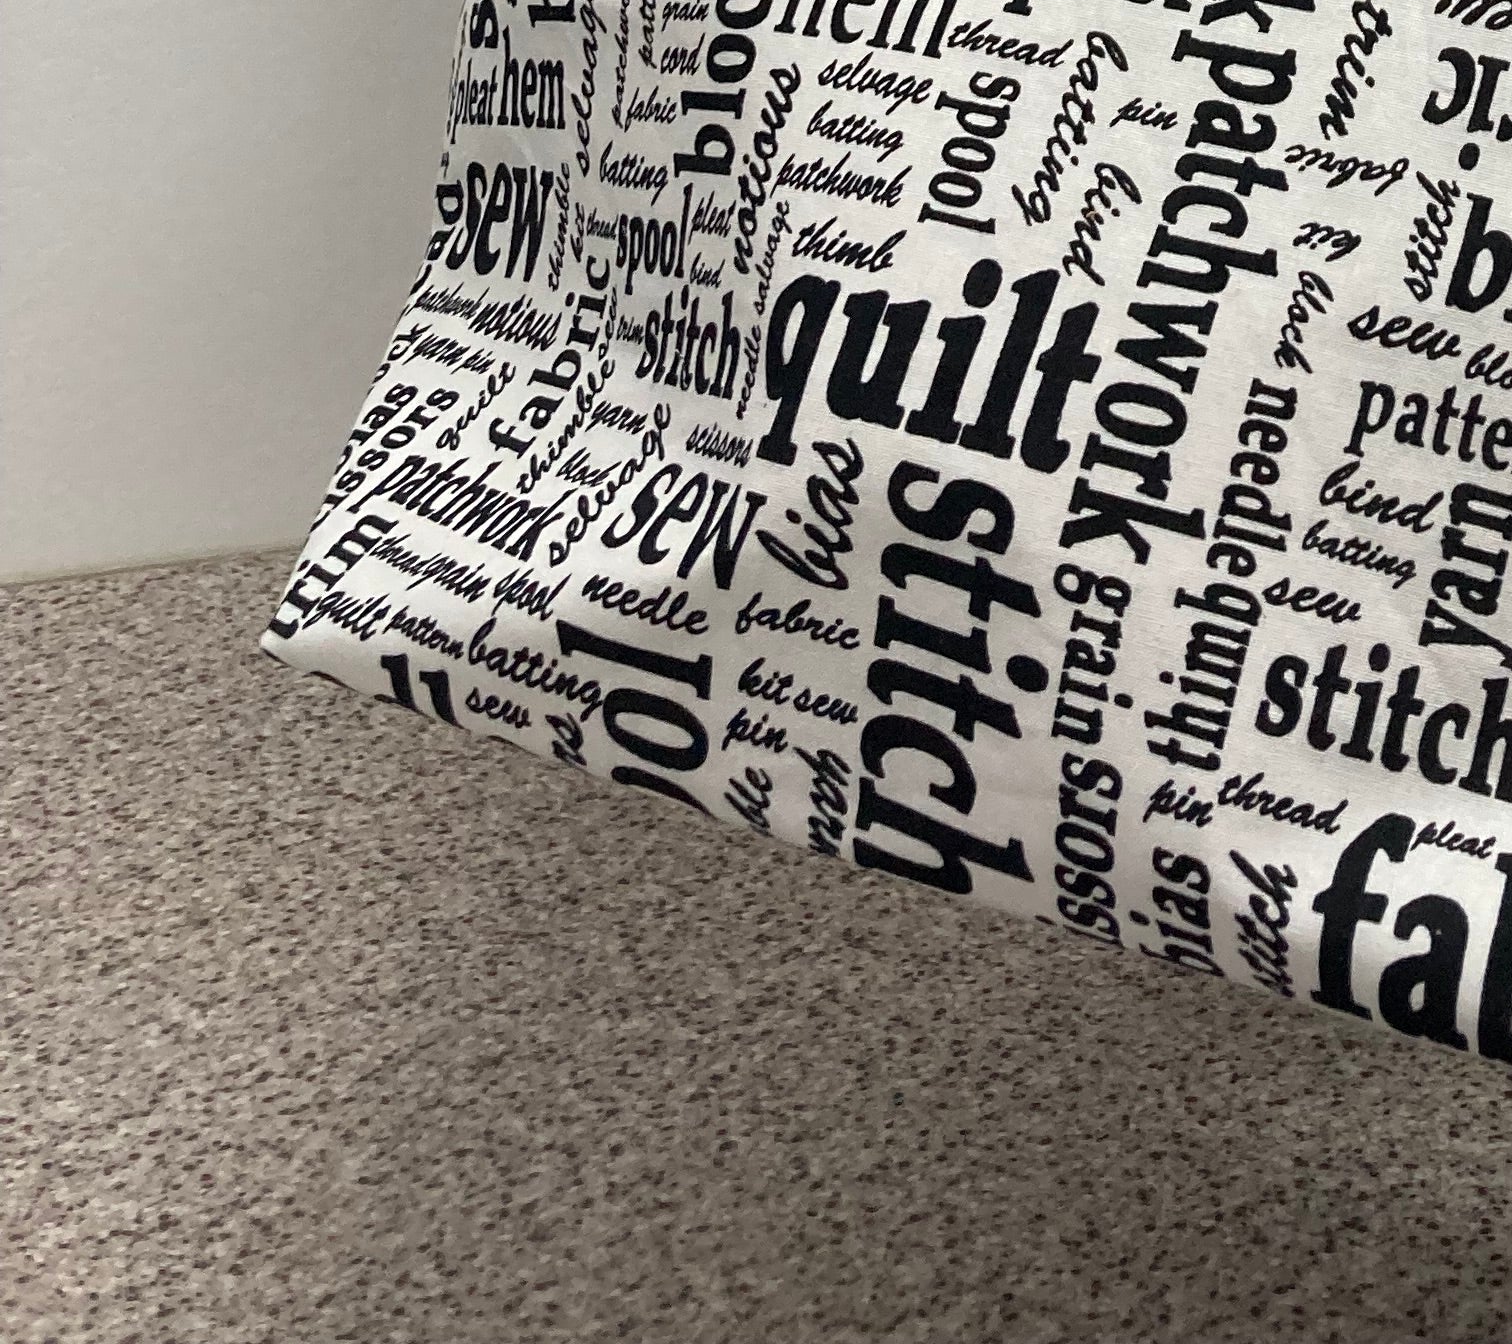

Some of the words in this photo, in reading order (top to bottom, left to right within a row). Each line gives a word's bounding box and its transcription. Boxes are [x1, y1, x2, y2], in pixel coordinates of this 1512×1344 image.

[818, 53, 933, 112] selvage
[1011, 31, 1128, 226] batting
[1319, 0, 1392, 140] trim
[917, 71, 1021, 234] spool
[443, 162, 570, 287] sew
[792, 216, 907, 272] thimb
[1062, 163, 1142, 286] bind
[1403, 171, 1460, 302] stitch
[484, 255, 617, 466] fabric
[630, 285, 741, 400] stitch
[756, 259, 1102, 474] quilt
[1052, 29, 1297, 571] patchwork
[1274, 271, 1334, 374] block
[516, 354, 620, 494] thimble
[548, 401, 676, 568] selvage
[1206, 378, 1297, 577] needle
[344, 450, 578, 568] patchwork
[601, 463, 768, 591] sew
[755, 438, 864, 590] bias
[1319, 461, 1444, 533] bind
[465, 617, 607, 725] batting
[848, 460, 1049, 896] stitch
[1051, 563, 1133, 745] grain
[1144, 583, 1262, 771] thimb
